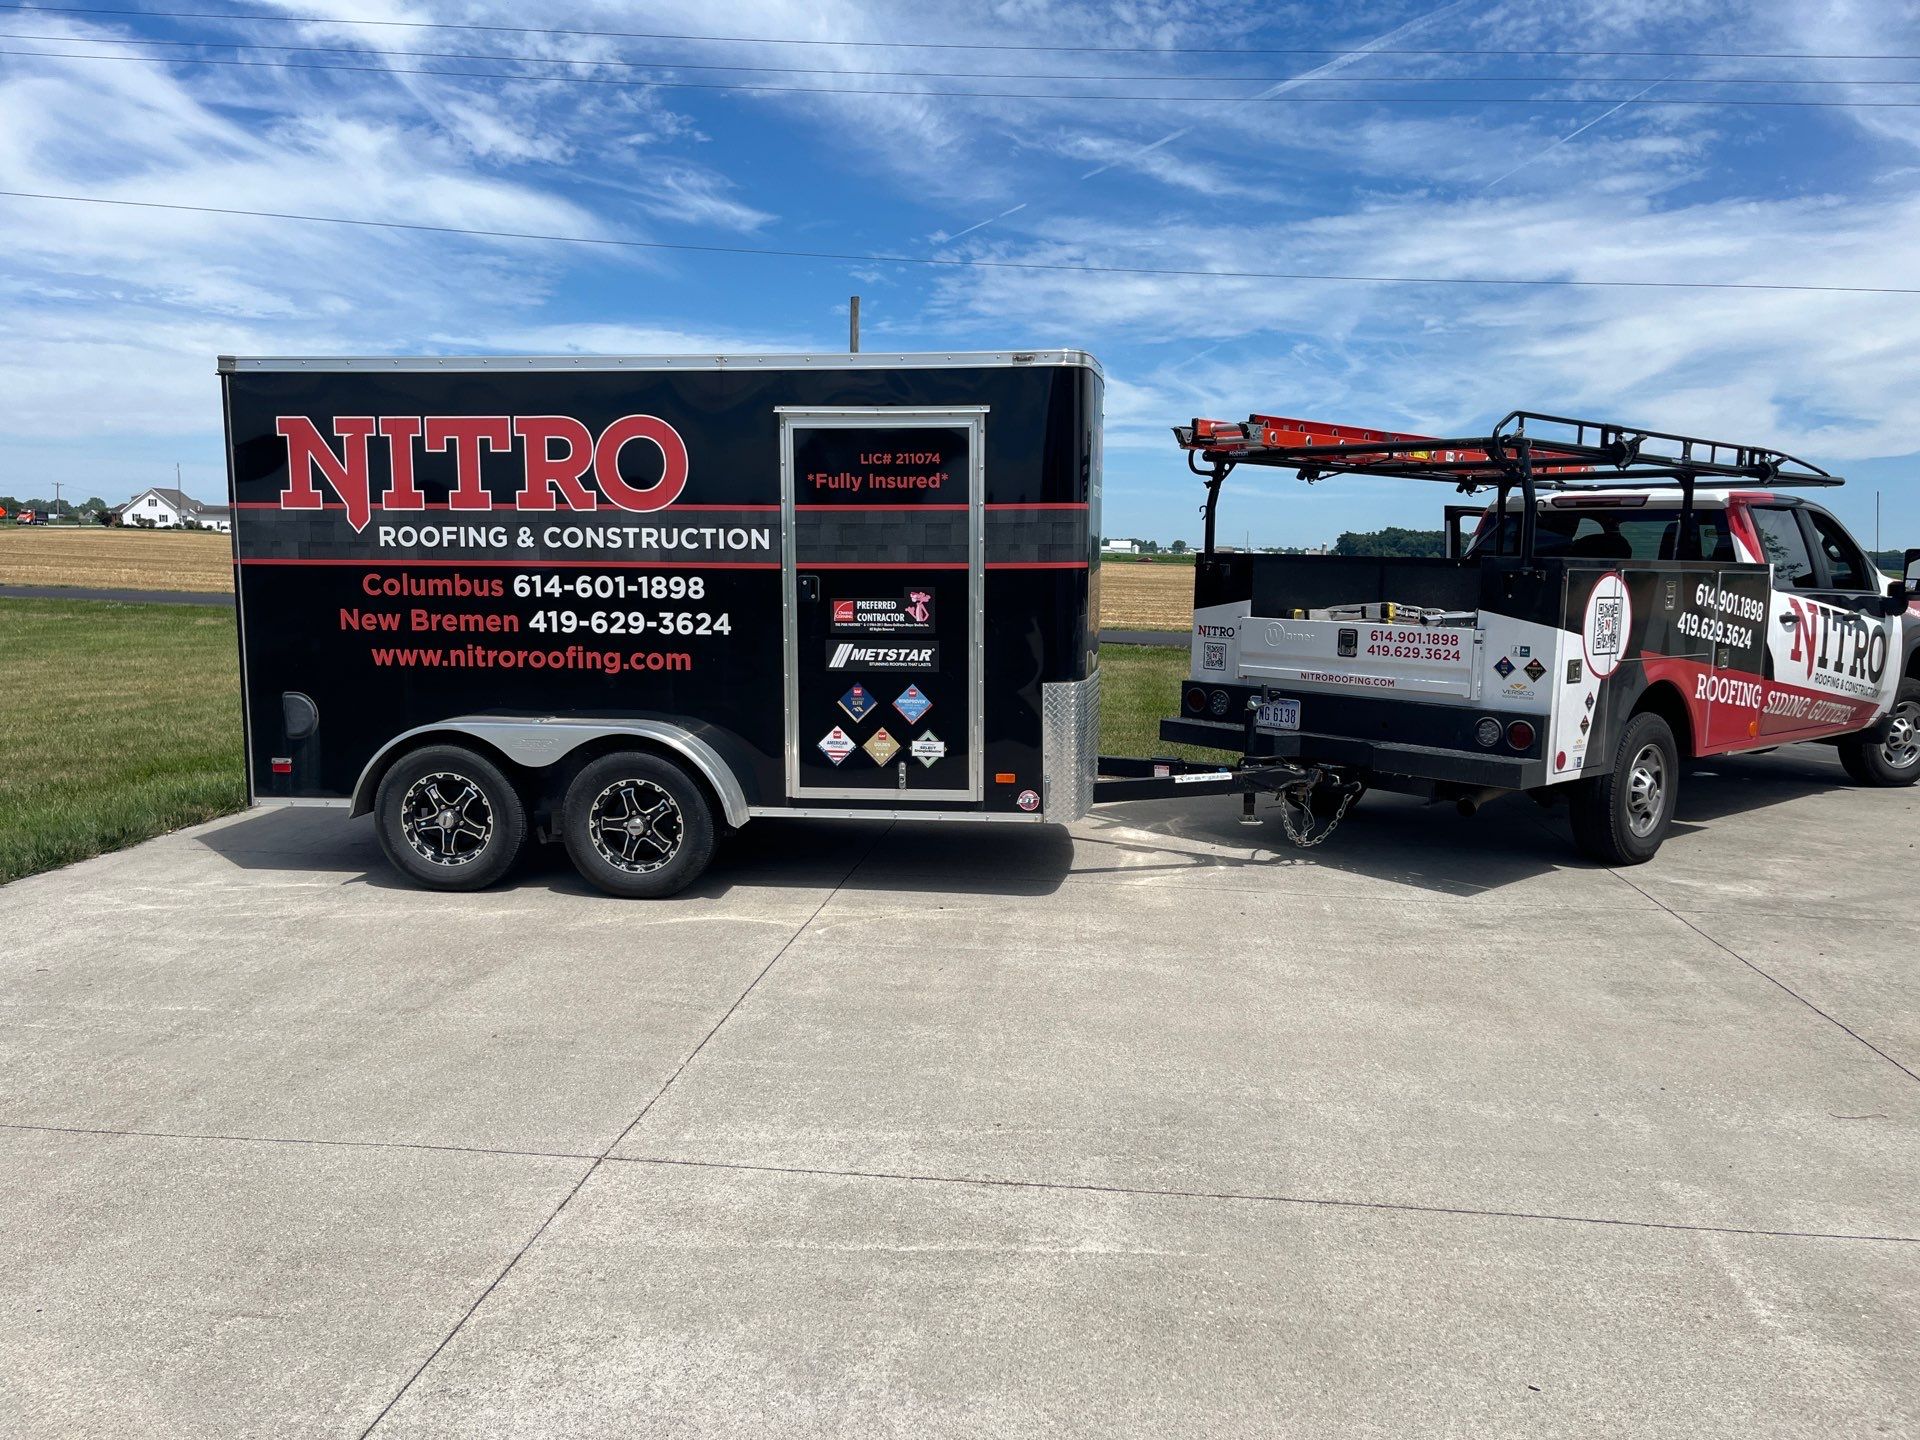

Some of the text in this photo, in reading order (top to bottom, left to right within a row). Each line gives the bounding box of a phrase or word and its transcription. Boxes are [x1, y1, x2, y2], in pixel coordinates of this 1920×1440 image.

[860, 453, 941, 465] LIC# 211074
[276, 414, 689, 533] NITRO
[379, 526, 771, 550] ROOFING & CONSTRUCTION
[362, 573, 705, 600] Columbus 614-601-1898
[856, 601, 897, 610] PREFERRED
[1695, 583, 1764, 622] 614.901.1898
[340, 608, 732, 635] New Bremen 419-629-3624
[857, 613, 905, 622] CONTRACTOR
[1198, 625, 1235, 637] NITRO
[1370, 630, 1459, 646] 614.901.1898
[1677, 611, 1752, 650] 419.629.3624
[1788, 597, 1887, 684] NITRO
[372, 644, 692, 674] www.nitroroofing.com
[1367, 645, 1461, 661] 419.629.3624
[1300, 672, 1395, 687] NITROROOFING.COM
[1815, 673, 1840, 689] ROOFING
[1845, 681, 1880, 698] CONSTRUCTION
[1695, 673, 1856, 725] ROOFING SIDING GUTTERS
[1273, 707, 1296, 724] 6138
